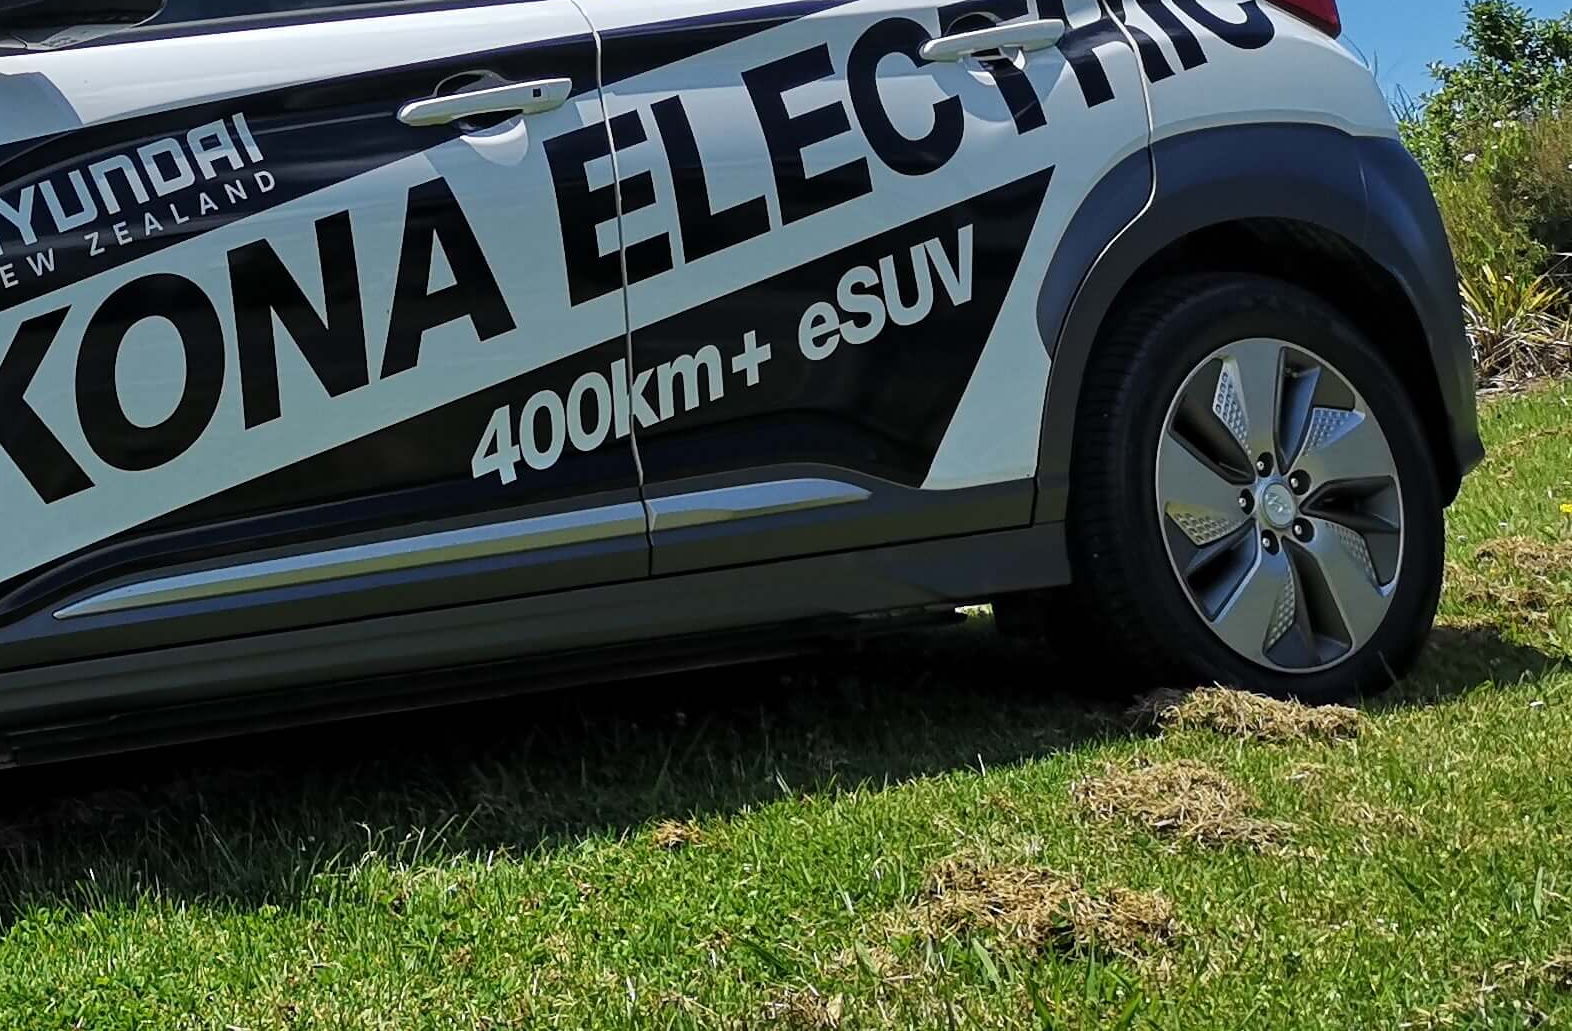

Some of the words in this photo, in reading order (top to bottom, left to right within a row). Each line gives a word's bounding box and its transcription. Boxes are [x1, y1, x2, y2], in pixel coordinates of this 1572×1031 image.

[84, 170, 277, 257] ZEALAND
[471, 331, 771, 485] 400km+
[799, 225, 975, 361] eSUV
